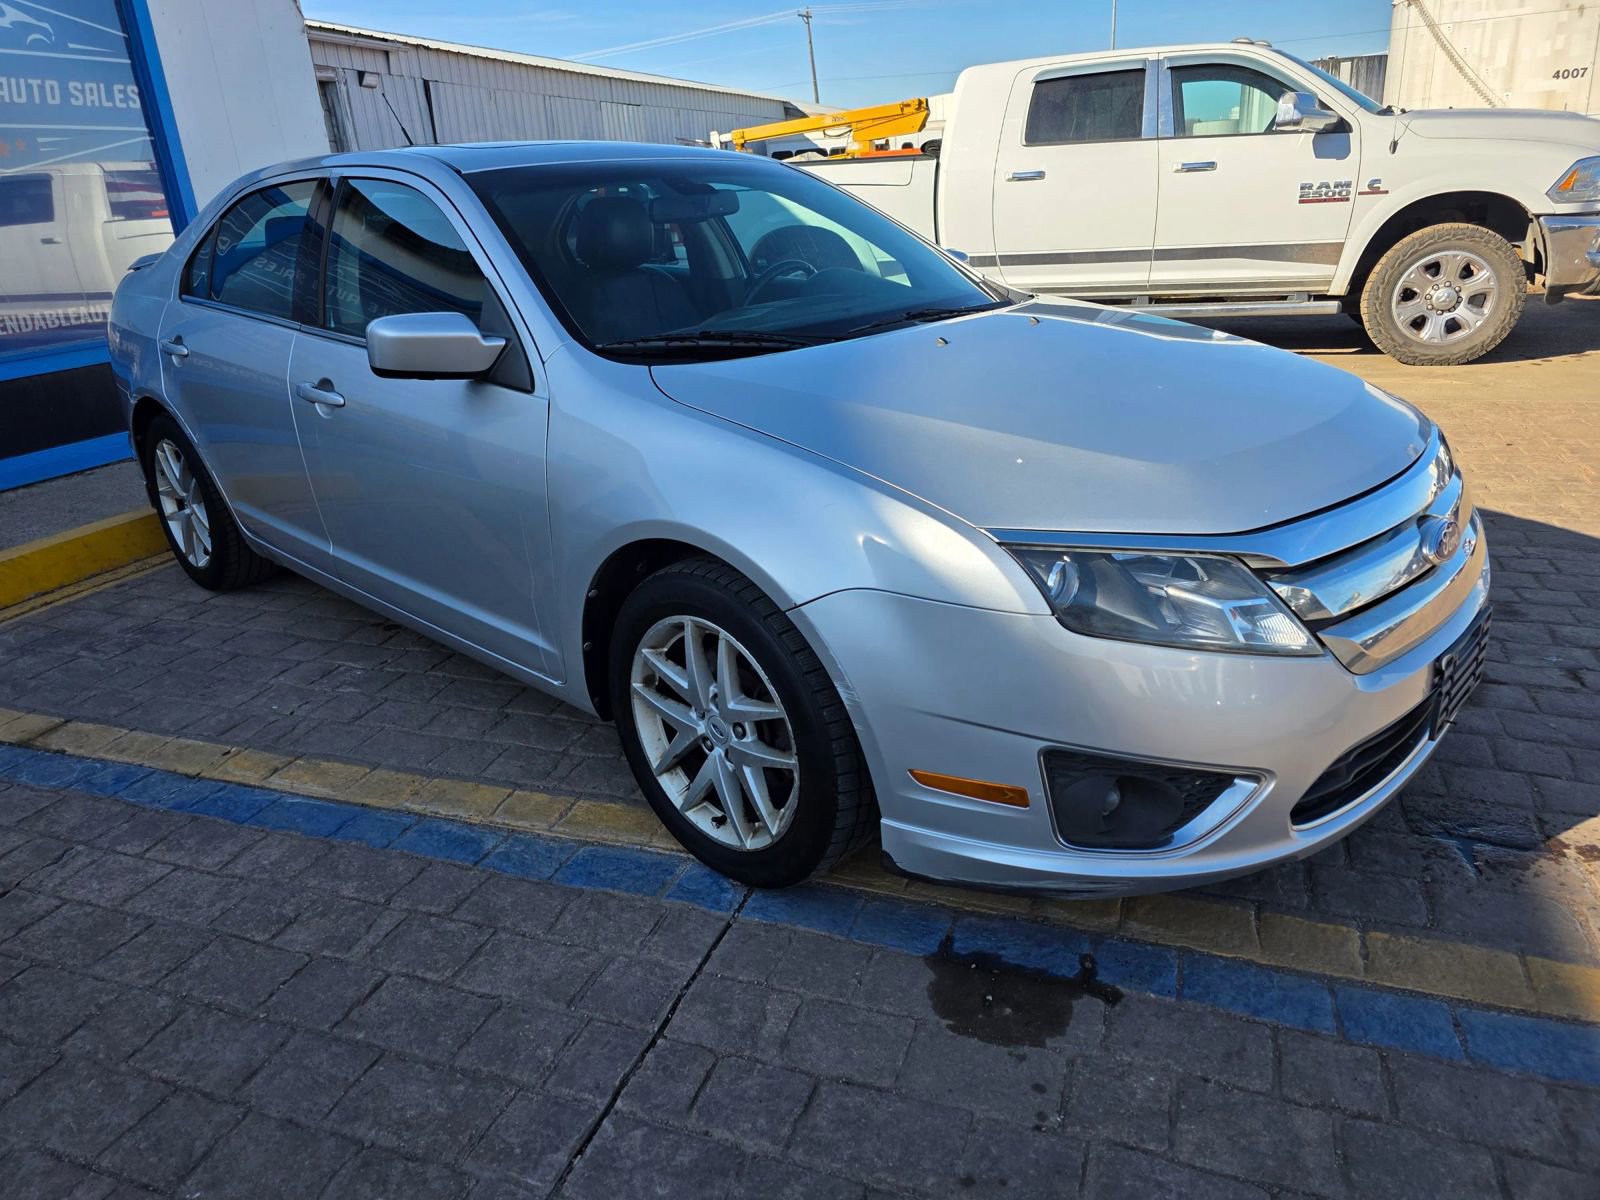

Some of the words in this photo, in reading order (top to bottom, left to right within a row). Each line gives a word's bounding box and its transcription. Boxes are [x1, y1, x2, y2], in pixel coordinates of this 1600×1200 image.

[1552, 67, 1588, 79] 4007
[0, 77, 61, 105] AUTO
[68, 81, 141, 109] SALES
[1300, 181, 1352, 190] RAM
[1299, 189, 1351, 199] 2500
